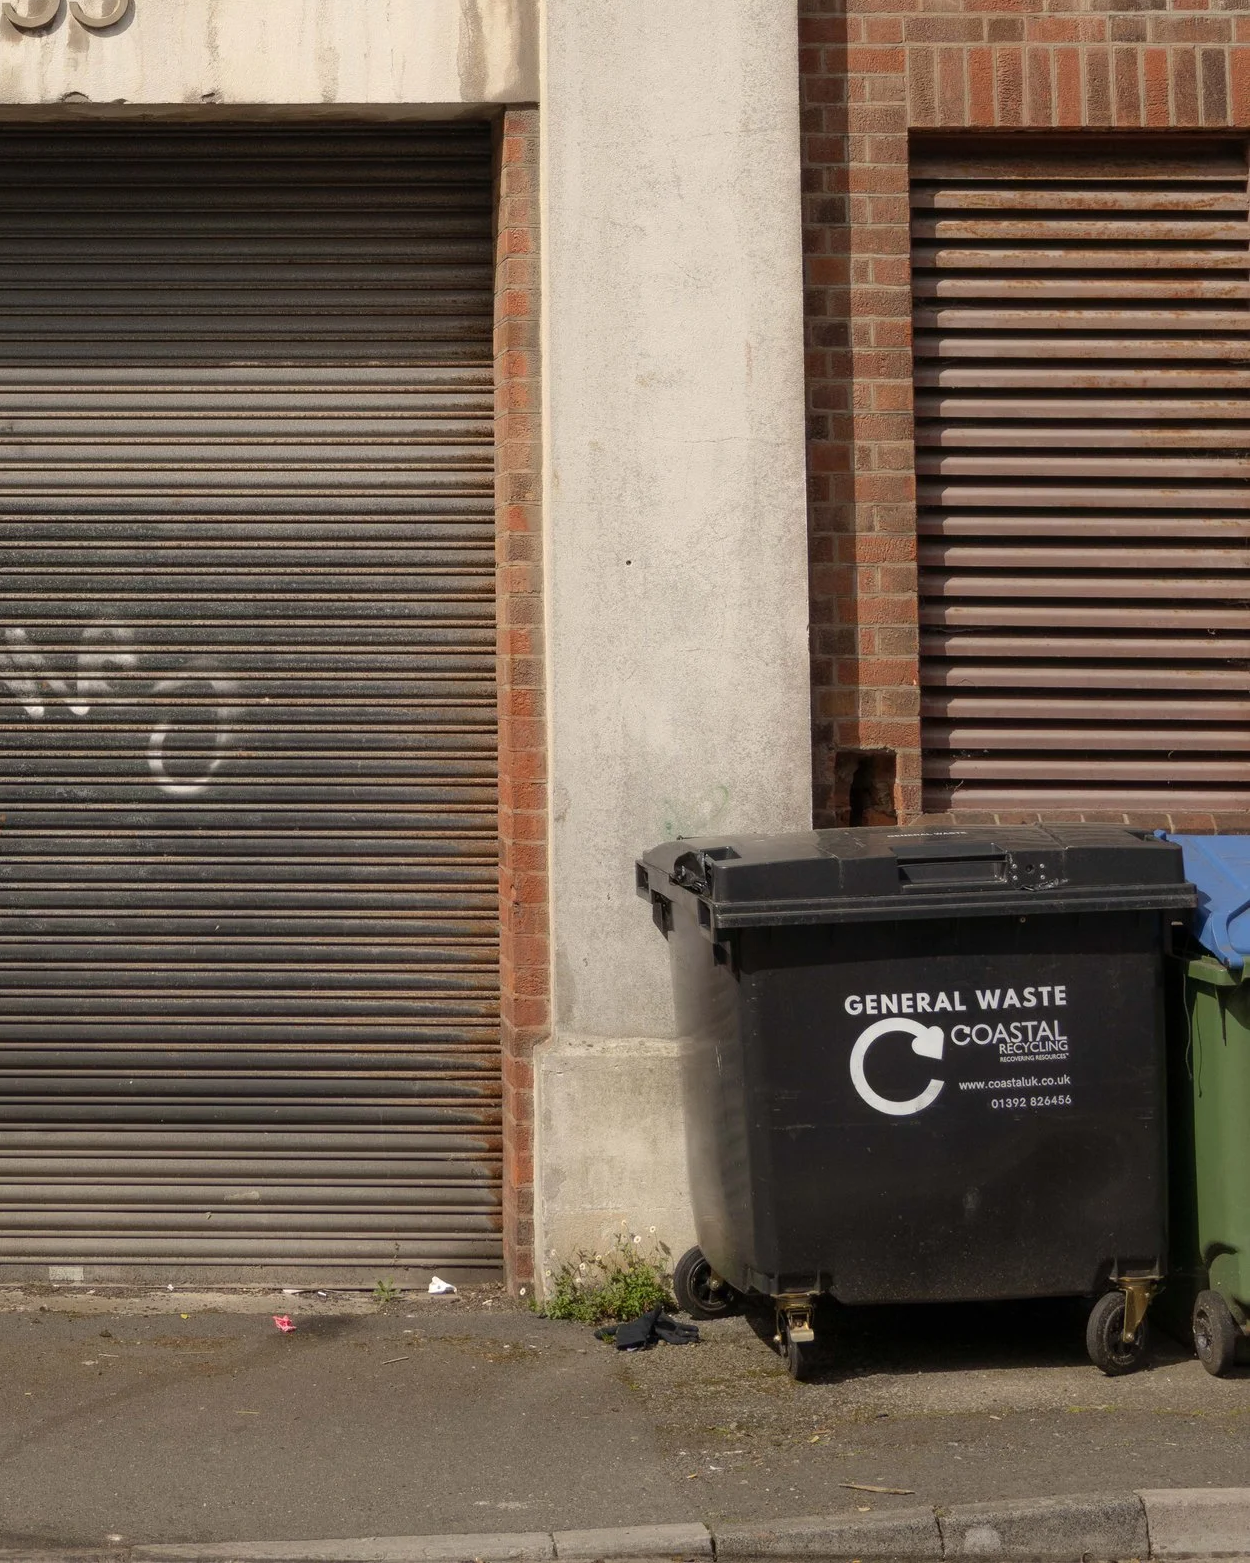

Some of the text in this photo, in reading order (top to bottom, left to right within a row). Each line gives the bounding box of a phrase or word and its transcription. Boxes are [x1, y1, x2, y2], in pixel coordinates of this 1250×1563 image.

[844, 985, 1068, 1016] GENERAL WASTE
[950, 1019, 1068, 1046] COASTAL
[999, 1040, 1069, 1055] RECYCLING
[1000, 1055, 1035, 1063] RECOVERING
[958, 1074, 1071, 1091] www.coastaluk.co.uk
[991, 1094, 1072, 1109] 01392 826456
